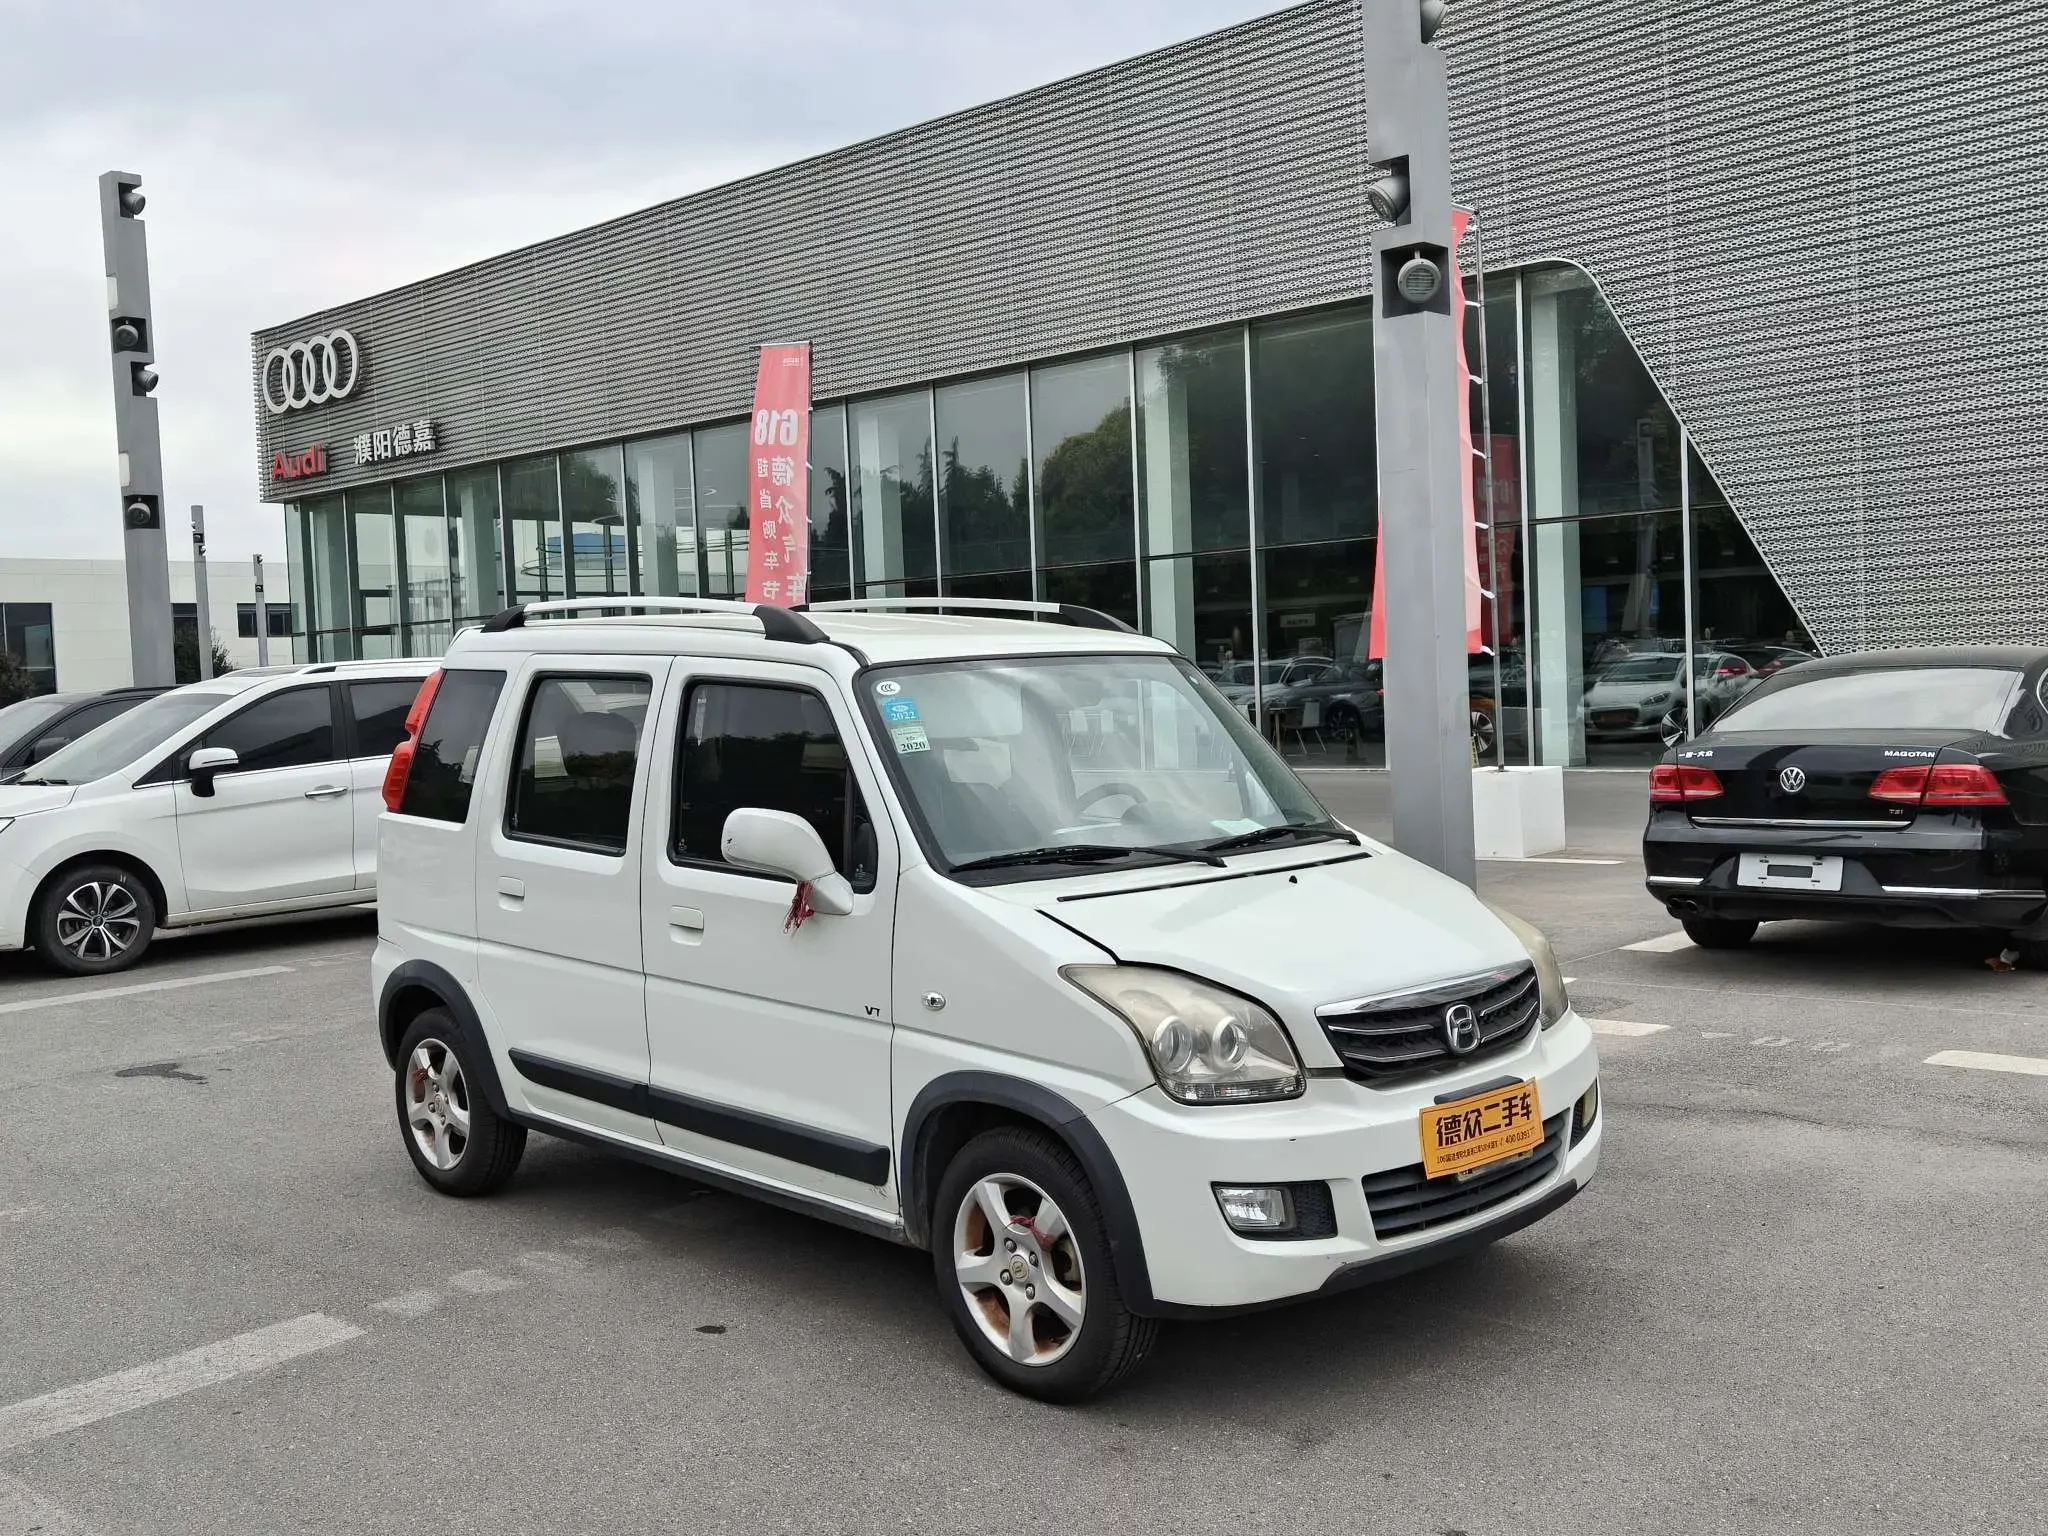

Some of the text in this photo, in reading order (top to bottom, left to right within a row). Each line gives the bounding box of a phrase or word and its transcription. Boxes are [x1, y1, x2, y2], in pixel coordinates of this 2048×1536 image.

[353, 420, 434, 464] 濮阳德嘉
[271, 441, 326, 482] Audi
[890, 711, 917, 721] 2022
[901, 741, 926, 752] 2020
[1884, 750, 1936, 758] MAGOTAN
[1435, 1091, 1533, 1147] 德众二手车
